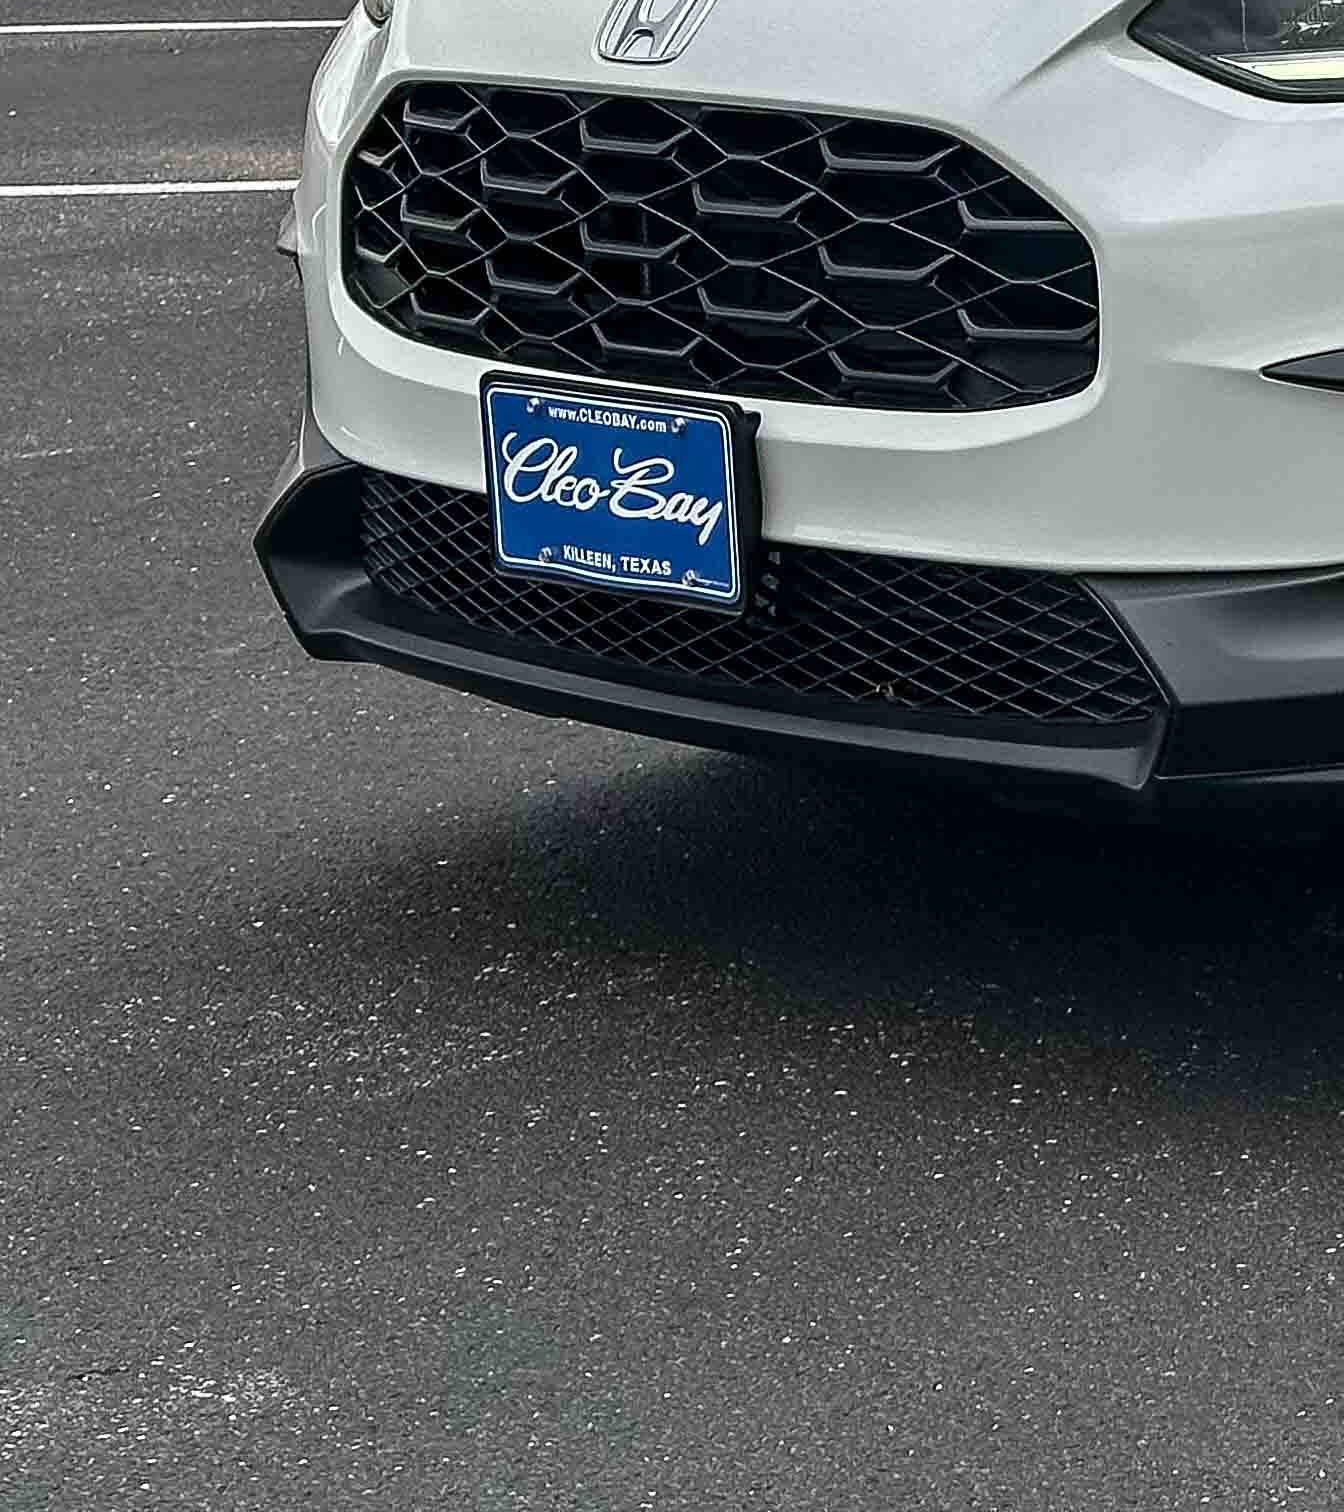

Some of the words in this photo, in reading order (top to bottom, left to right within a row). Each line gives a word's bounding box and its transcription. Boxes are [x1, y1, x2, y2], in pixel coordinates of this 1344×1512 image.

[549, 406, 667, 433] www.CLEOBAY.com
[501, 432, 611, 510] Cleo
[609, 448, 722, 546] Bay
[563, 544, 616, 573] KILLEEN,
[620, 555, 672, 576] TEXAS
